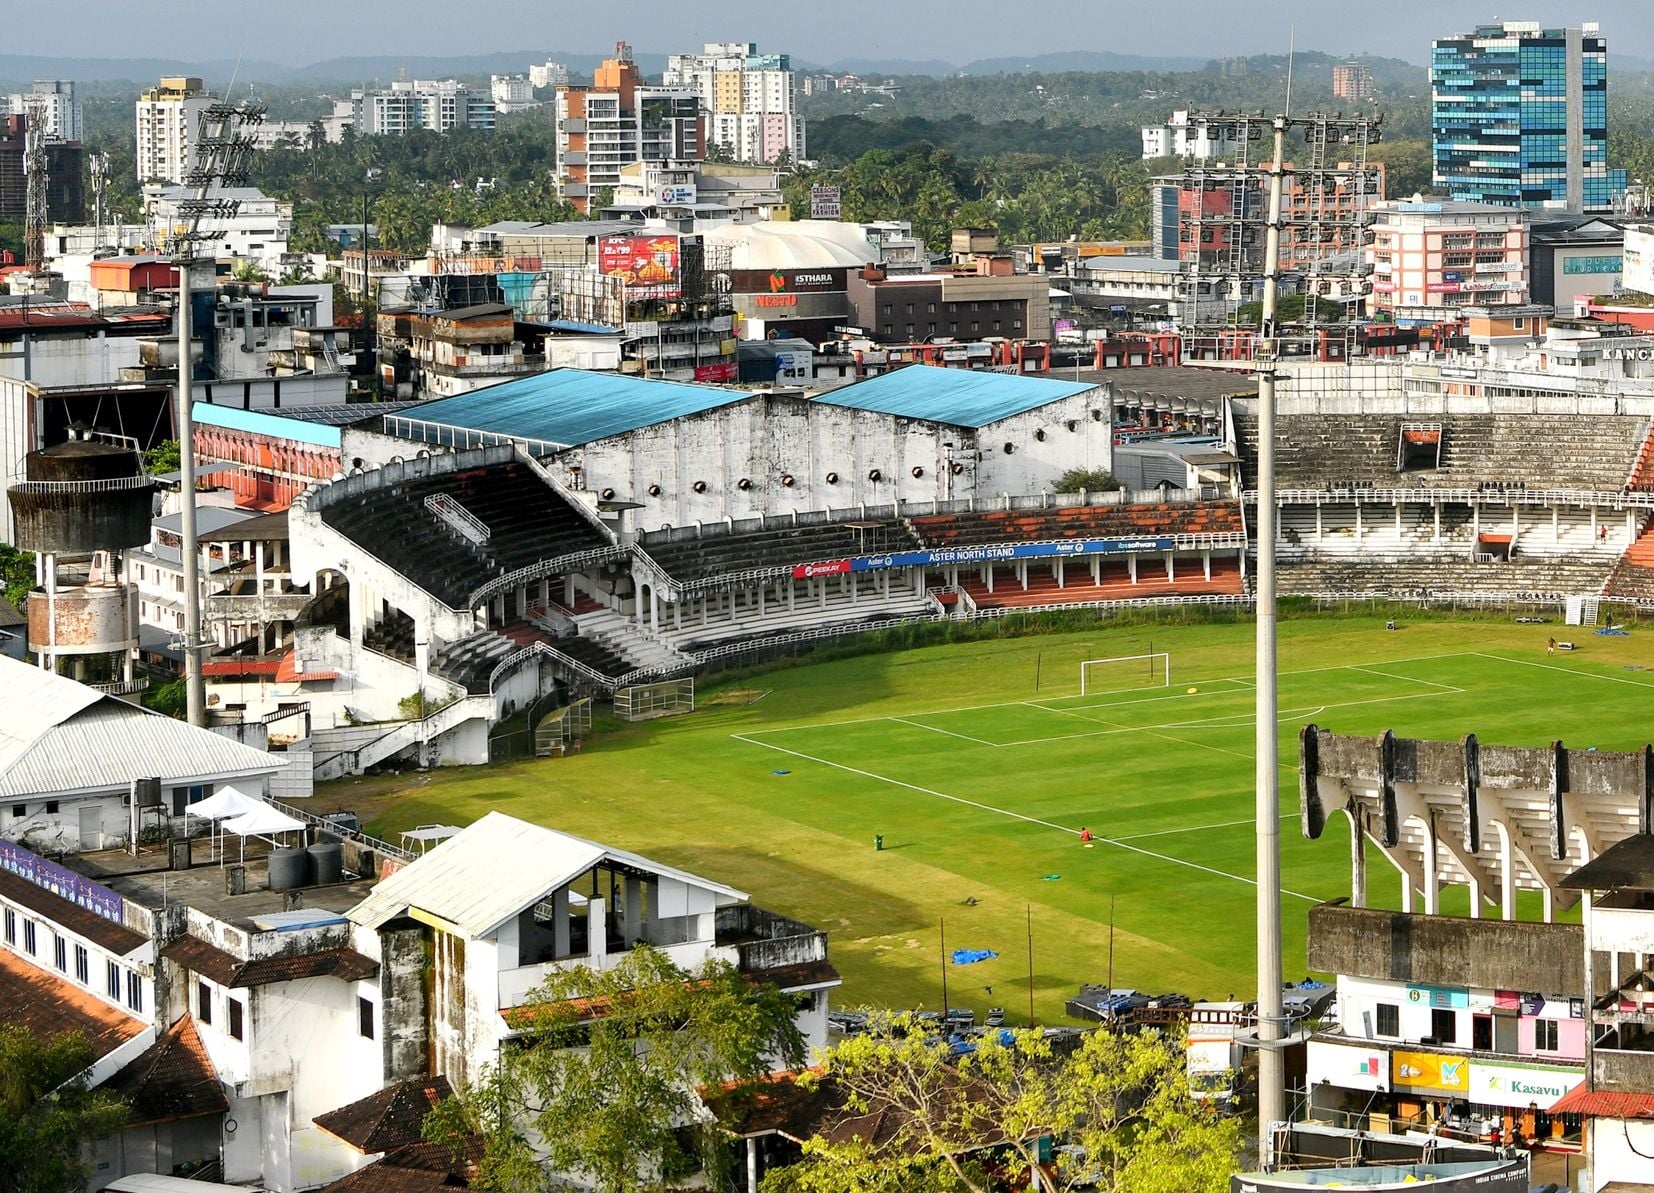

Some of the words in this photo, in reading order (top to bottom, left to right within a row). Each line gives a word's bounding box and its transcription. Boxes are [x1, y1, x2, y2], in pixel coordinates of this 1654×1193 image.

[756, 294, 798, 307] NESTO
[1056, 543, 1074, 551] Aster
[929, 551, 955, 562] ASTER
[957, 549, 985, 560] NORTH
[986, 547, 1015, 558] STAND
[867, 558, 884, 566] Aster
[1511, 1080, 1560, 1096] Kasavu
